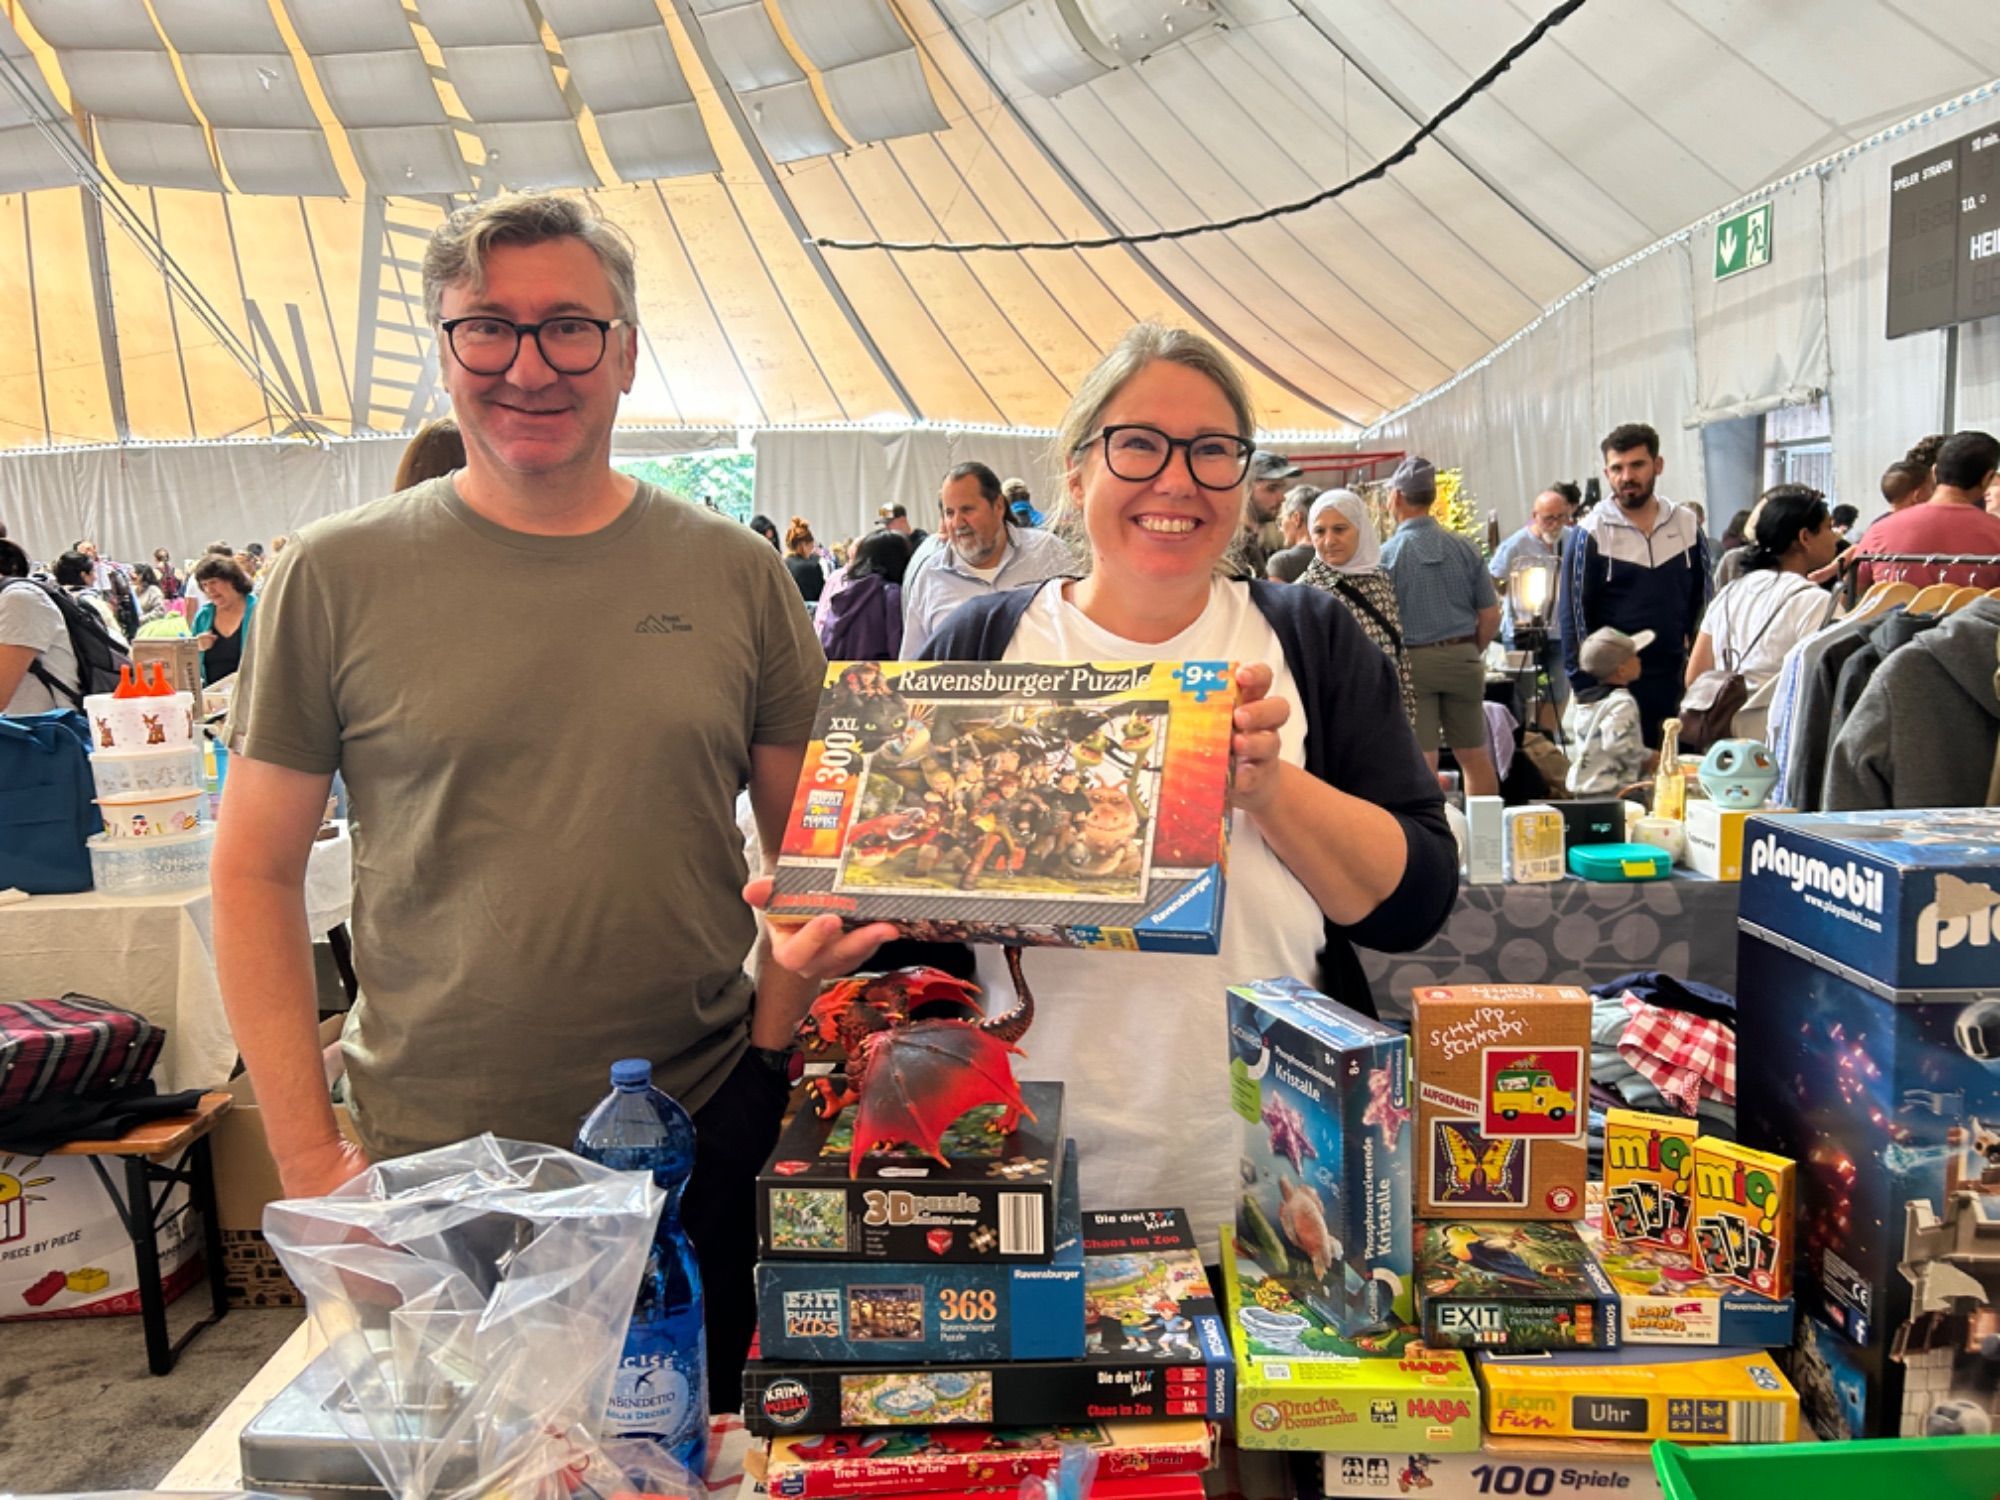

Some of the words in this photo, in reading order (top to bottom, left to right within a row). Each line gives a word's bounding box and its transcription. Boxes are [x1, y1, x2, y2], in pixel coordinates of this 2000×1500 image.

[899, 669, 1064, 695] Ravensburger
[1070, 669, 1151, 693] Puzzle
[1184, 665, 1217, 685] 9+
[829, 717, 860, 732] XXL
[815, 732, 857, 785] 300
[1751, 834, 1884, 914] playmobil
[1151, 875, 1212, 925] Ravensburger
[1804, 893, 1883, 934] www.playmobil.com
[1444, 1017, 1533, 1061] SCHNAPP!
[1275, 1062, 1321, 1103] Kristalle
[1364, 1137, 1375, 1261] Phosphoreszierende
[1696, 1160, 1778, 1234] mio!
[1095, 1214, 1116, 1225] Die
[1121, 1213, 1145, 1223] drei
[1378, 1178, 1392, 1257] Kristalle
[2, 1245, 31, 1261] PIECE
[34, 1241, 49, 1254] BY
[51, 1230, 82, 1248] PIECE
[1083, 1238, 1127, 1249] Chaos
[1131, 1237, 1149, 1247] im
[1153, 1235, 1180, 1246] Zoo
[1013, 1269, 1080, 1281] Ravensburger
[939, 1289, 998, 1321] 368
[1724, 1302, 1790, 1314] Ravensburger
[940, 1322, 996, 1333] Ravensburger
[1440, 1306, 1500, 1330] EXIT
[1606, 1303, 1617, 1346] KOSMOS
[940, 1332, 967, 1342] Puzzle
[1202, 1317, 1227, 1358] KOSMOS
[623, 1353, 674, 1371] CISE
[1398, 1361, 1462, 1375] HABA
[1097, 1371, 1113, 1384] Die
[1115, 1371, 1133, 1384] drei
[1215, 1368, 1226, 1414] KOSMOS
[1497, 1392, 1556, 1412] Learn
[1087, 1404, 1118, 1417] Chaos
[1119, 1404, 1132, 1416] im
[1134, 1403, 1153, 1416] Zoo
[1407, 1398, 1470, 1424] HABA
[1497, 1408, 1554, 1429] Fun
[1590, 1403, 1632, 1423] Uhr
[833, 1467, 859, 1479] Tree
[867, 1465, 900, 1477] Baum
[1471, 1464, 1555, 1496] 100
[1560, 1470, 1631, 1490] Spiele
